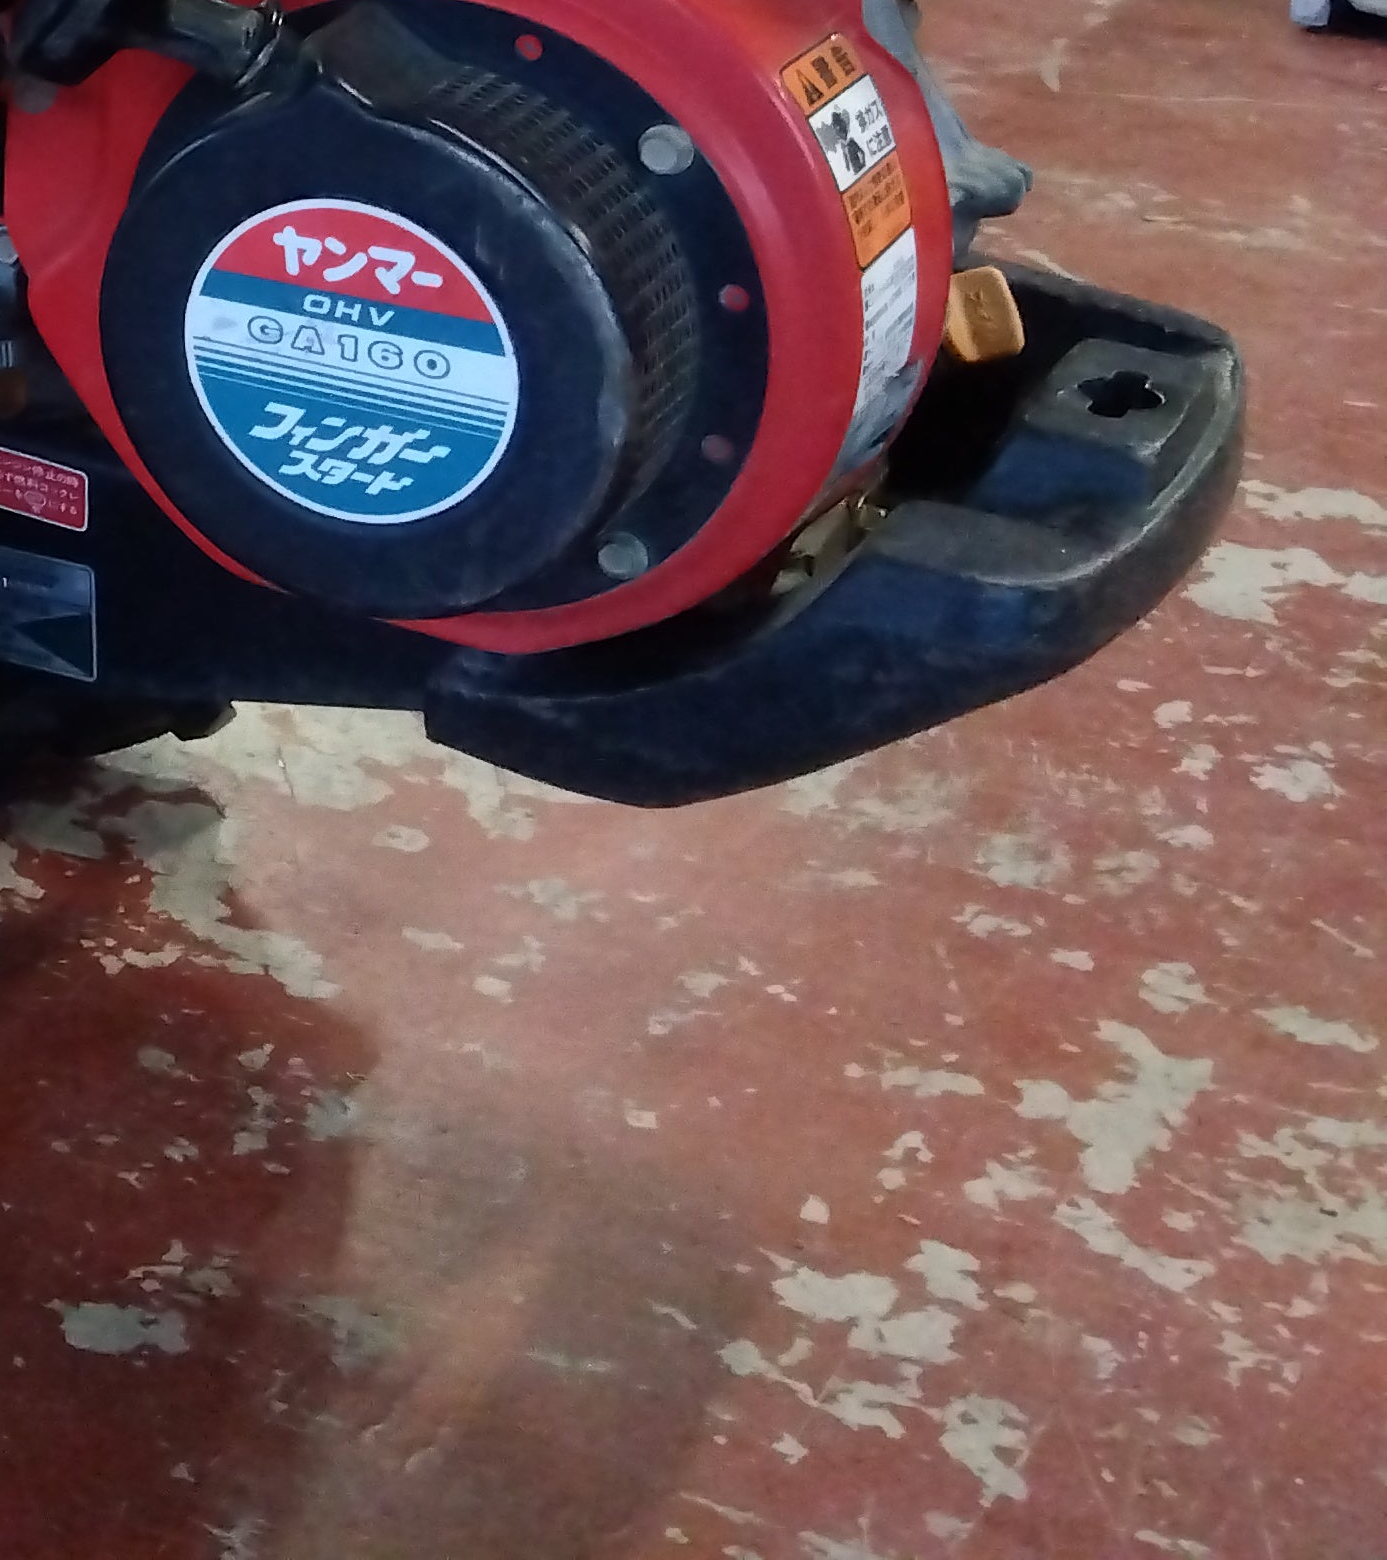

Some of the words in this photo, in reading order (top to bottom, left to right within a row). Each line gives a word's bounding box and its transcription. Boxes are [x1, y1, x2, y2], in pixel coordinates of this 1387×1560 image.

[273, 226, 443, 294] ヤンマー
[303, 294, 395, 328] OHV
[247, 315, 451, 379] GA160
[248, 401, 452, 465] フィンガー
